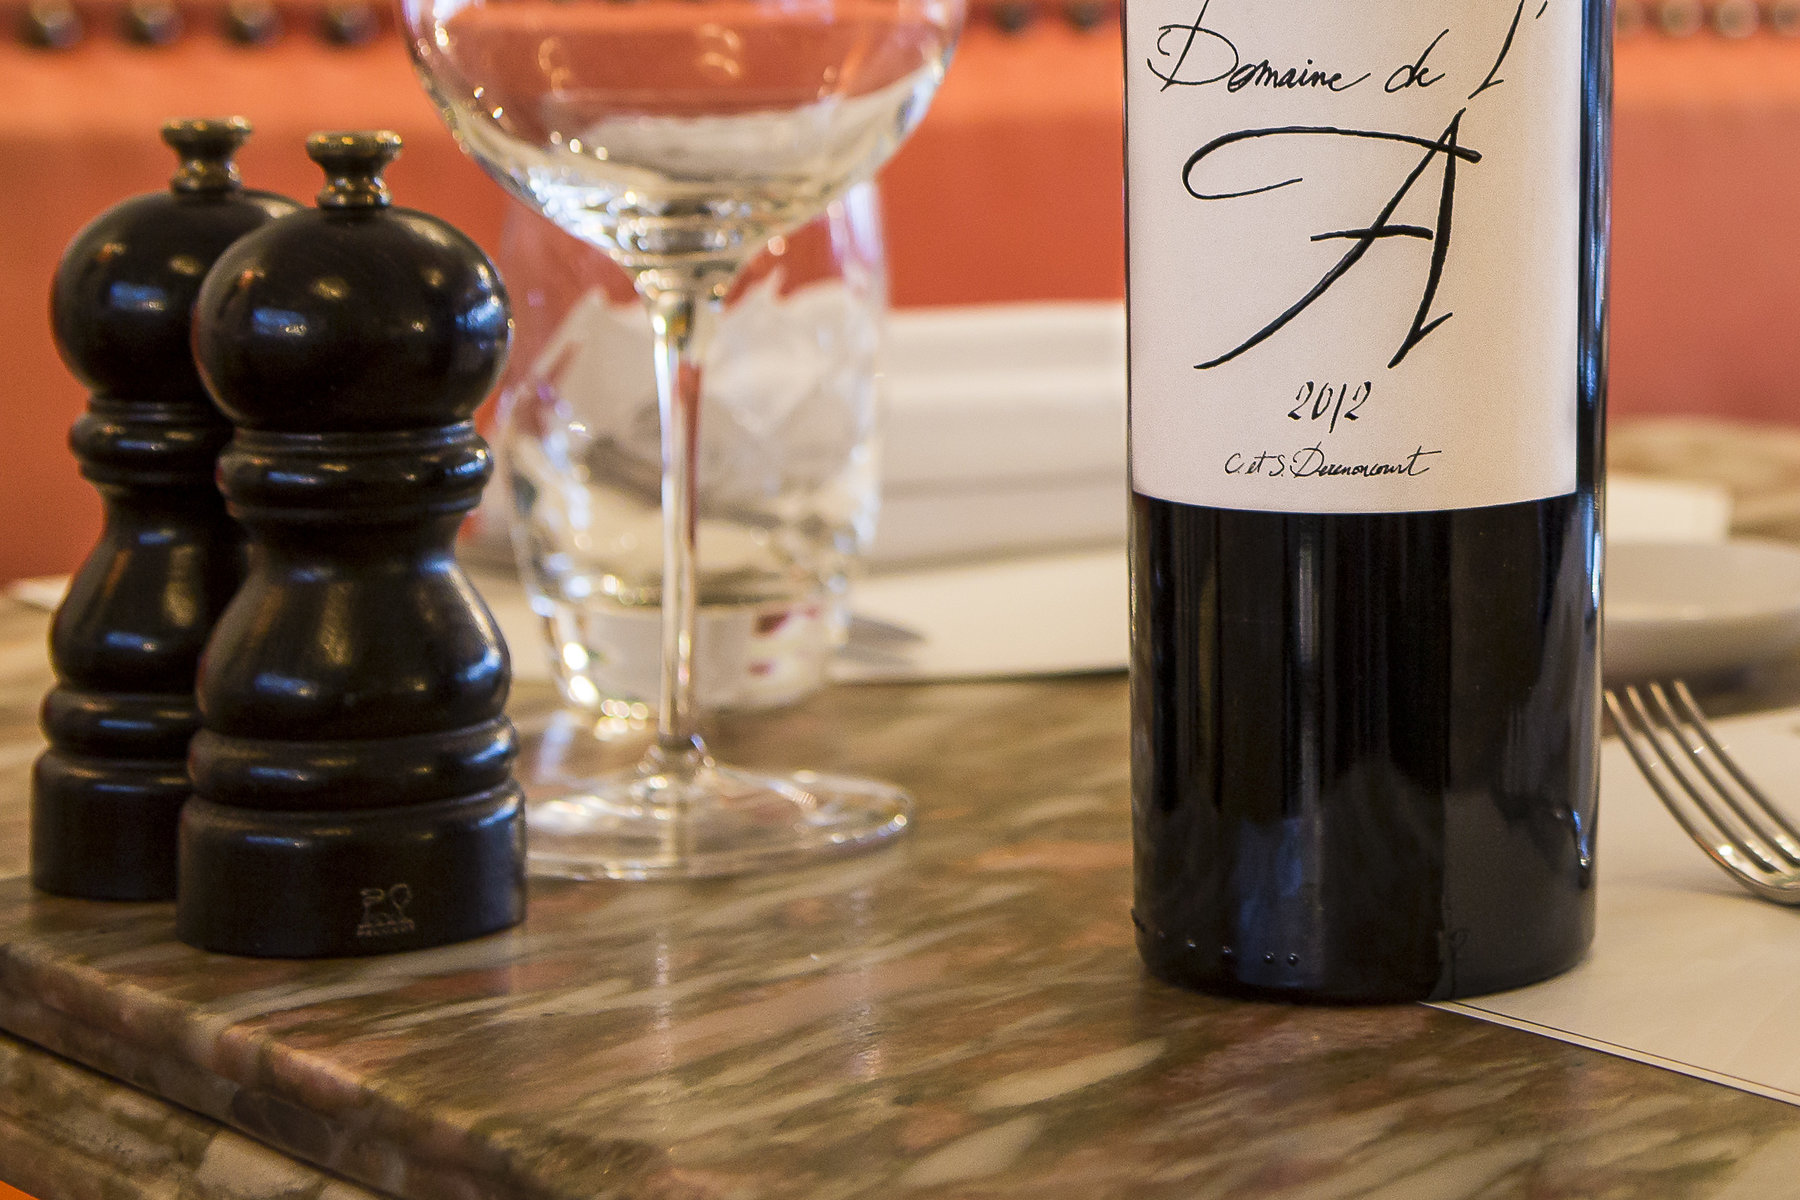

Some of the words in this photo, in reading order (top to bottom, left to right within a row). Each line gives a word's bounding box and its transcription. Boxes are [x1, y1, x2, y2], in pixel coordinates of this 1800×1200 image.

[1384, 28, 1450, 94] de
[1181, 107, 1483, 370] A
[1287, 380, 1373, 434] 2012
[1245, 450, 1278, 475] et
